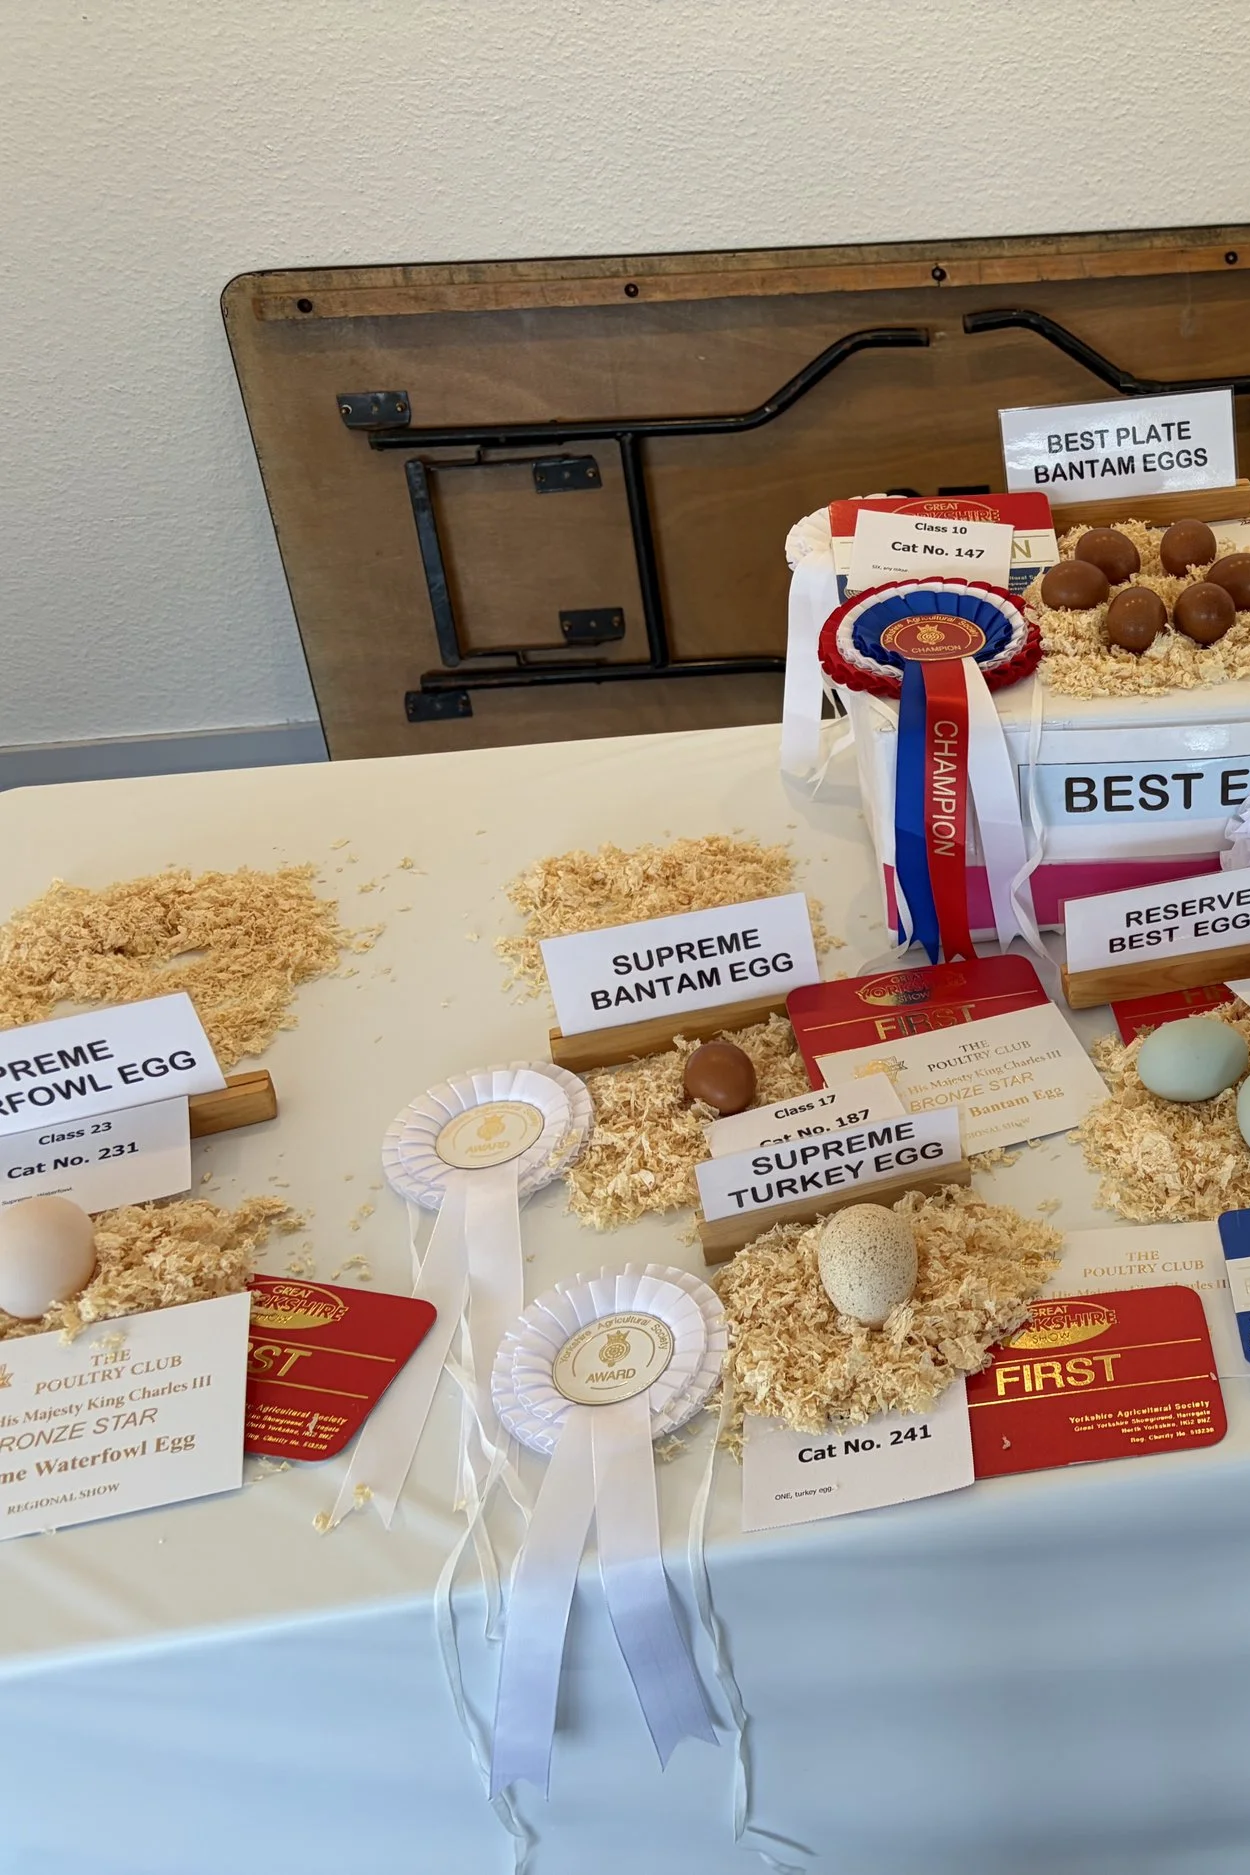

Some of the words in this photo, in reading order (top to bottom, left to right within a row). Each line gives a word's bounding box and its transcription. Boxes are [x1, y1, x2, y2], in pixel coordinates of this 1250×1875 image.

[1047, 429, 1109, 453] BEST
[1116, 421, 1191, 447] PLATE
[1034, 455, 1135, 484] BANTAM
[1143, 448, 1208, 472] EGGS
[924, 502, 959, 511] GREAT
[915, 522, 948, 533] Class
[952, 526, 967, 535] 10
[891, 542, 918, 553] Cat
[923, 545, 948, 556] No.
[955, 548, 984, 559] 147
[911, 645, 961, 653] CHAMPION
[932, 720, 959, 856] CHAMPION
[1065, 773, 1204, 813] BEST
[613, 929, 761, 975] SUPREME
[1109, 927, 1179, 953] BEST
[591, 967, 721, 1010] BANTAM
[729, 953, 794, 982] EGG
[898, 991, 930, 1003] SHOW
[874, 1004, 976, 1040] FIRST
[927, 1050, 990, 1073] POULTRY
[995, 1040, 1031, 1055] CLUB
[959, 1040, 989, 1053] THE
[117, 1050, 196, 1085] EGG
[908, 1083, 929, 1095] His
[930, 1072, 973, 1090] Majesty
[975, 1066, 1002, 1078] King
[1004, 1055, 1045, 1071] Charles
[1047, 1049, 1062, 1059] III
[774, 1102, 814, 1119] Class
[818, 1095, 836, 1106] 17
[909, 1084, 985, 1112] BRONZE
[990, 1072, 1034, 1091] STAR
[968, 1095, 1030, 1118] Bantam
[1032, 1087, 1064, 1101] Egg
[39, 1129, 85, 1145] Class
[90, 1121, 112, 1135] 23
[797, 1126, 831, 1138] No.
[835, 1109, 870, 1128] 187
[7, 1162, 46, 1179] Cat
[53, 1155, 89, 1170] No.
[98, 1141, 139, 1160] 231
[752, 1122, 915, 1176] SUPREME
[728, 1160, 864, 1209] TURKEY
[874, 1142, 944, 1172] EGG
[1083, 1262, 1158, 1278] POULTRY
[1162, 1260, 1204, 1272] CLUB
[1125, 1251, 1159, 1262] THE
[272, 1285, 315, 1298] GREAT
[1032, 1305, 1069, 1317] GREAT
[559, 1330, 592, 1365] Yorkshire
[597, 1315, 651, 1330] Agricultural
[650, 1323, 668, 1350] Society
[1032, 1332, 1070, 1344] SHOW
[90, 1349, 132, 1367] THE
[34, 1366, 125, 1396] POULTRY
[130, 1355, 183, 1375] CLUB
[585, 1368, 636, 1384] AWARD
[996, 1354, 1121, 1396] FIRST
[23, 1403, 83, 1424] Majesty
[87, 1394, 125, 1410] King
[129, 1383, 188, 1401] Charles
[192, 1375, 212, 1390] III
[256, 1404, 311, 1418] Agricultural
[1069, 1413, 1113, 1424] Yorkshire
[1117, 1404, 1172, 1417] Agricultural
[1174, 1400, 1210, 1410] Society
[0, 1421, 87, 1452] RONZE
[92, 1407, 158, 1435] STAR
[1097, 1420, 1129, 1429] Yorkshire
[35, 1440, 147, 1477] Waterfowl
[154, 1434, 196, 1453] Egg
[798, 1444, 836, 1463] Cat
[844, 1439, 881, 1455] No.
[890, 1424, 932, 1446] 241
[7, 1492, 76, 1515] REGIONAL
[78, 1483, 120, 1500] SHOW
[775, 1493, 793, 1501] ONE,
[795, 1489, 816, 1498] turkey
[819, 1485, 834, 1493] egg.
